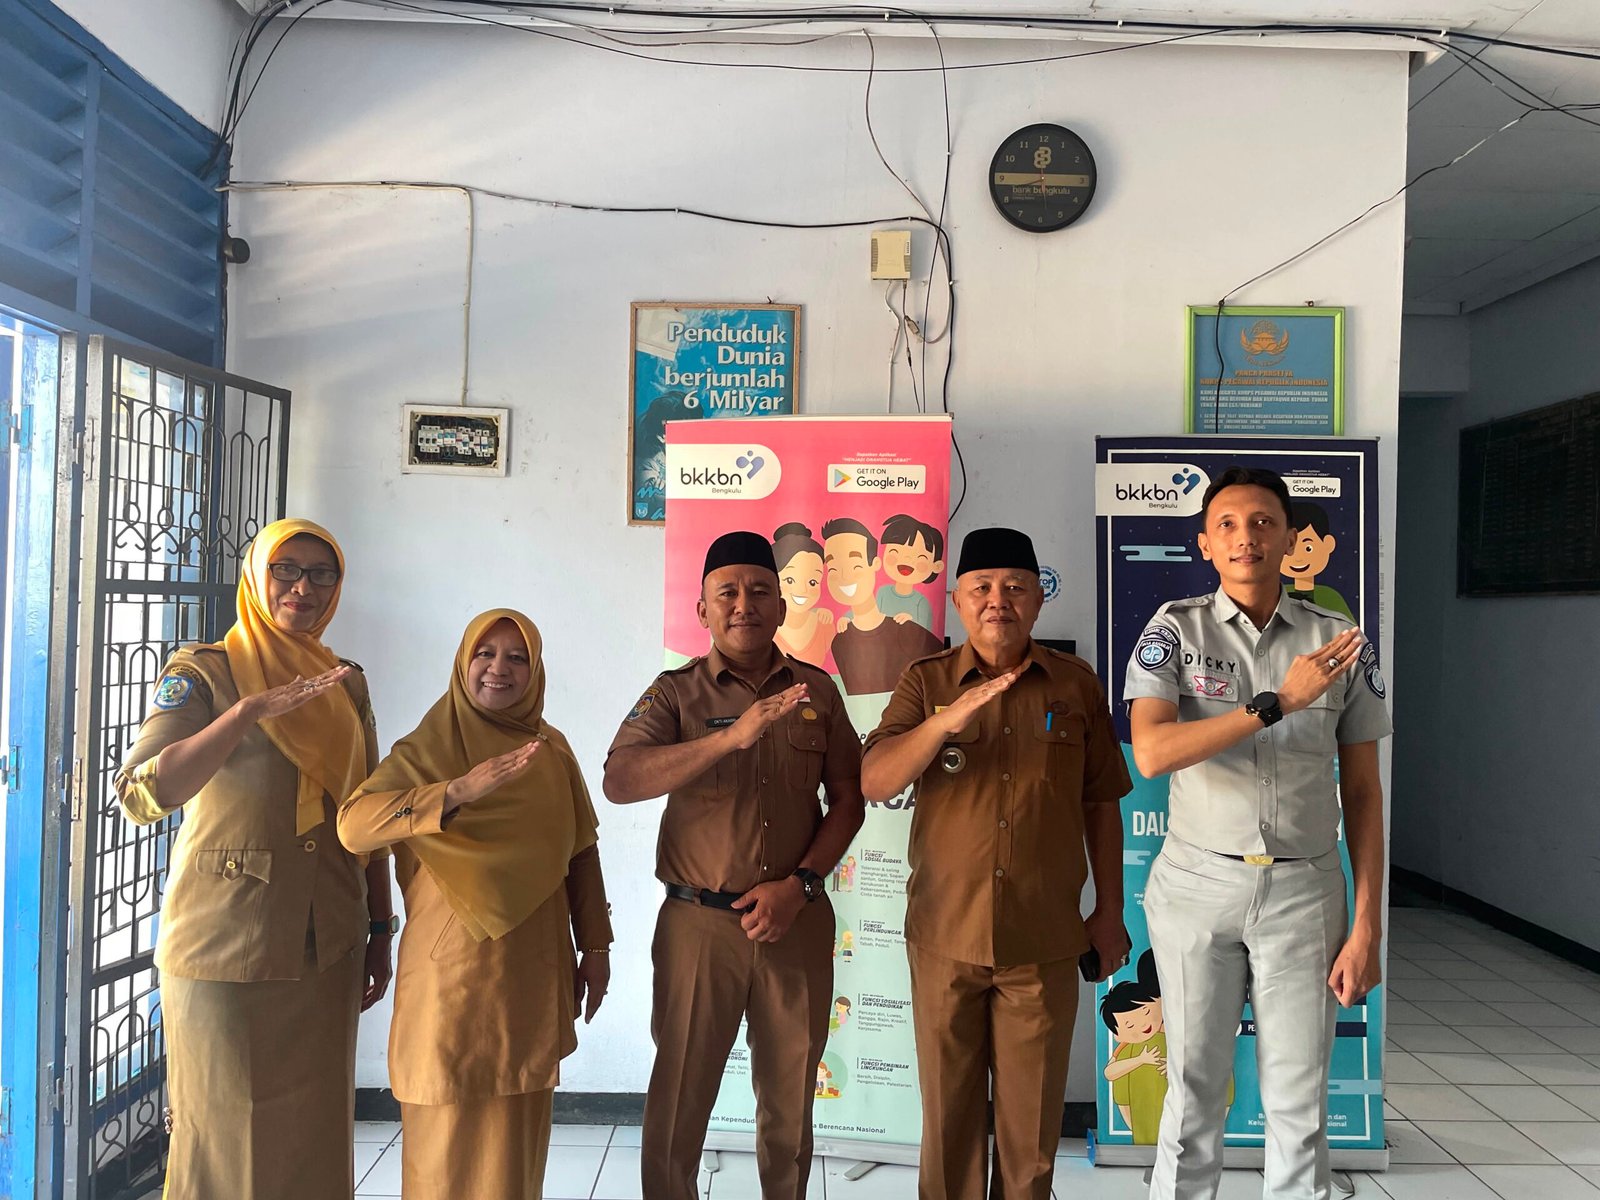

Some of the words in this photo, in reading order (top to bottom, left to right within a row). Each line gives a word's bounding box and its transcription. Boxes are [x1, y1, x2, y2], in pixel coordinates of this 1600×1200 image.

[668, 322, 787, 344] Penduduk
[718, 346, 785, 366] Dunia
[665, 366, 785, 390] berjumlah
[684, 390, 700, 409] 6
[710, 390, 784, 415] Milyar
[680, 467, 742, 485] bkkbn
[856, 476, 895, 490] Google
[898, 477, 919, 490] Play
[1116, 484, 1178, 500] bkkbn
[1292, 485, 1320, 494] Google
[1321, 486, 1336, 494] Play
[1184, 653, 1236, 672] DICKY
[819, 1123, 855, 1131] Berencana
